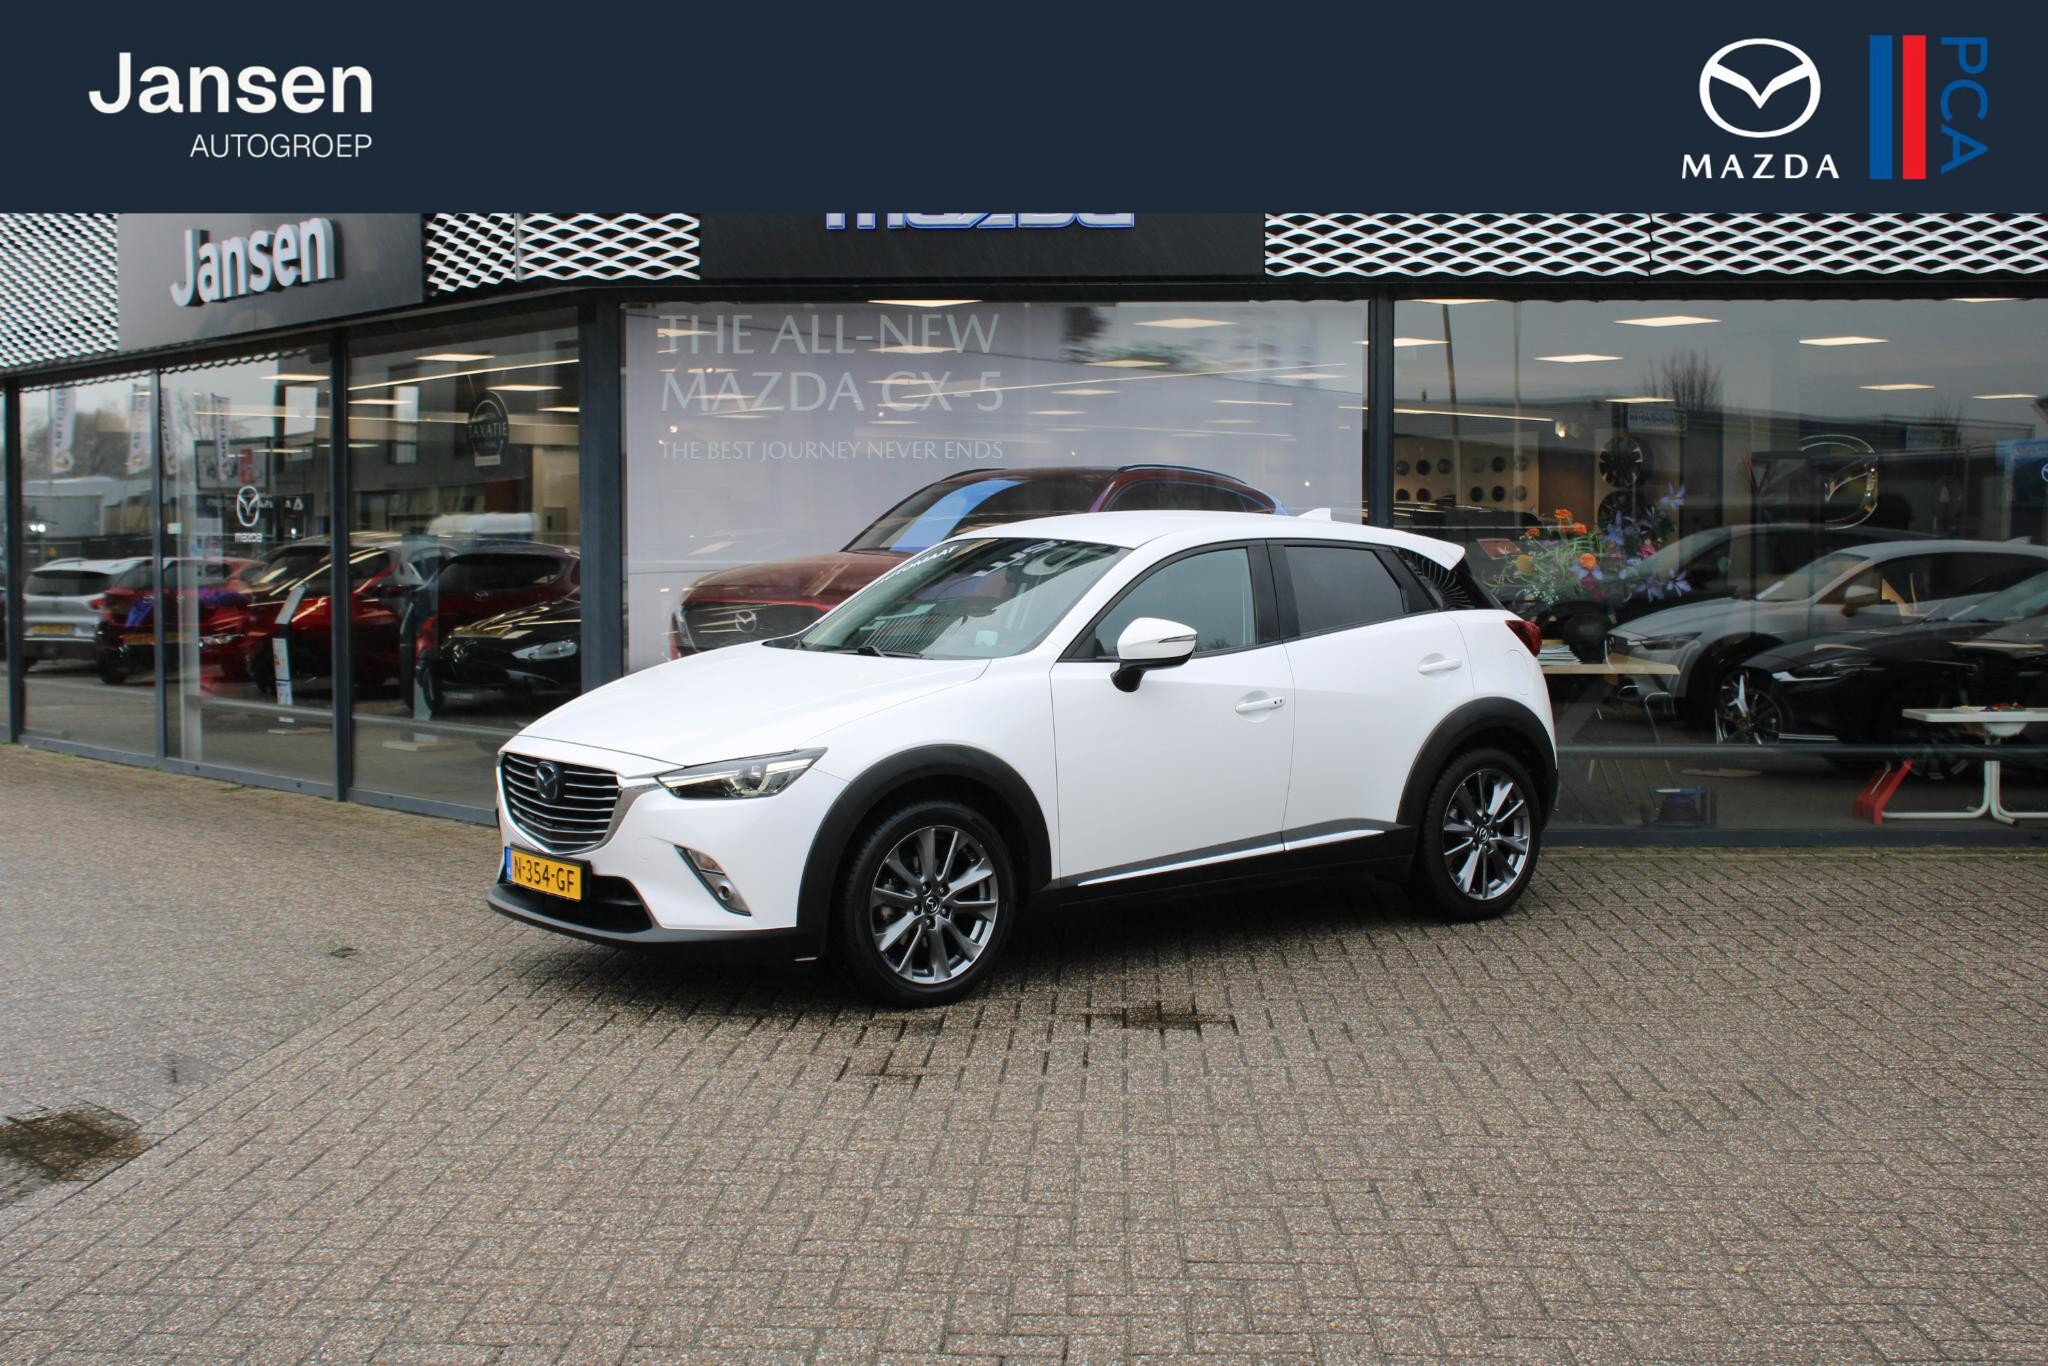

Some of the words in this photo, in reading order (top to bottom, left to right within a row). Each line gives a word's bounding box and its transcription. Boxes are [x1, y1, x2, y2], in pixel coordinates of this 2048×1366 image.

[169, 217, 336, 307] Jansen
[659, 314, 755, 354] THE
[769, 314, 999, 354] ALL-NEW
[661, 371, 865, 412] MAZDA
[881, 370, 1004, 412] CX-5
[662, 441, 701, 459] THE
[707, 441, 755, 459] BEST
[760, 441, 861, 463] JOURNEY
[867, 441, 937, 459] NEVER
[944, 441, 1003, 459] ENDS
[513, 855, 575, 893] N-354-GF
